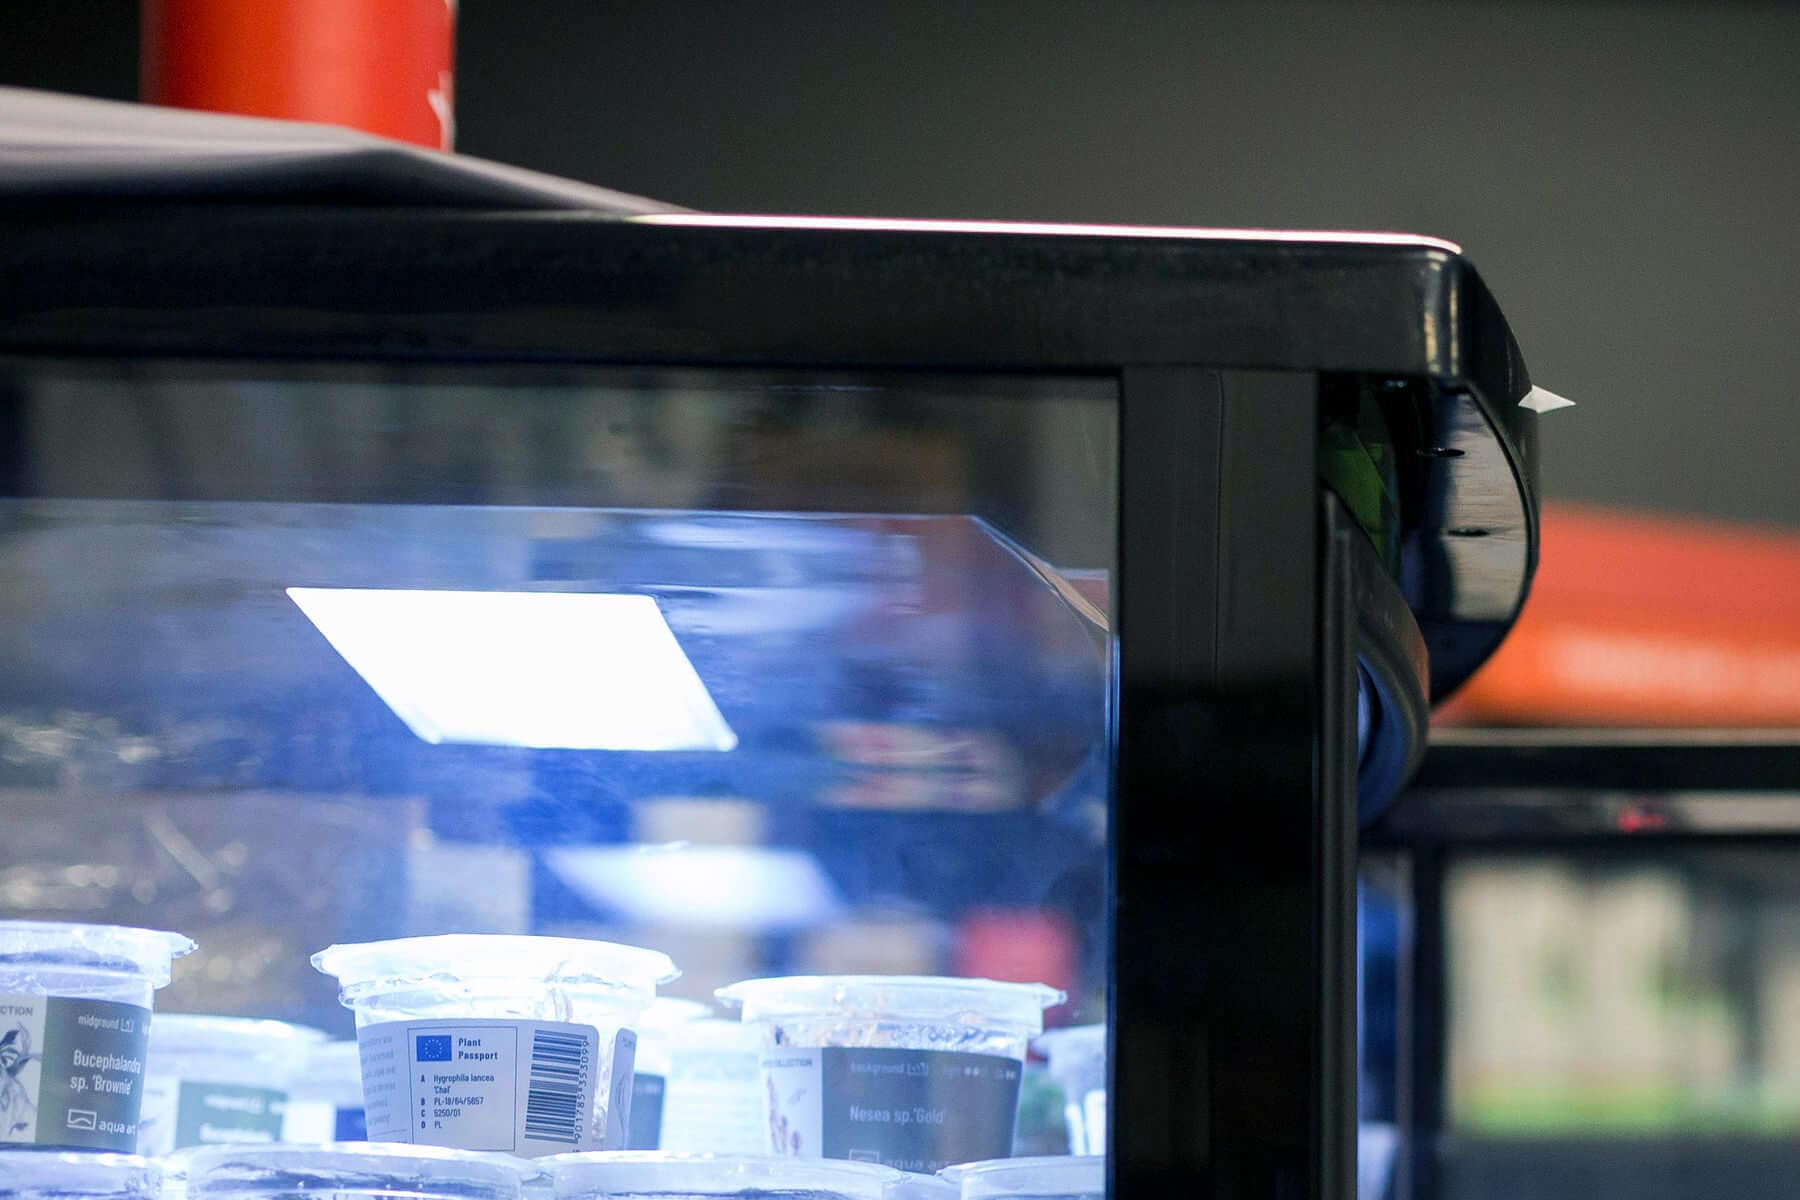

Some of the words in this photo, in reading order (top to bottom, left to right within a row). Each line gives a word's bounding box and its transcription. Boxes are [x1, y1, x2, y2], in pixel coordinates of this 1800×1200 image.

[458, 1037, 481, 1047] Plant
[458, 1051, 498, 1062] Passport
[70, 1076, 89, 1093] sp.
[99, 1120, 126, 1134] aqua
